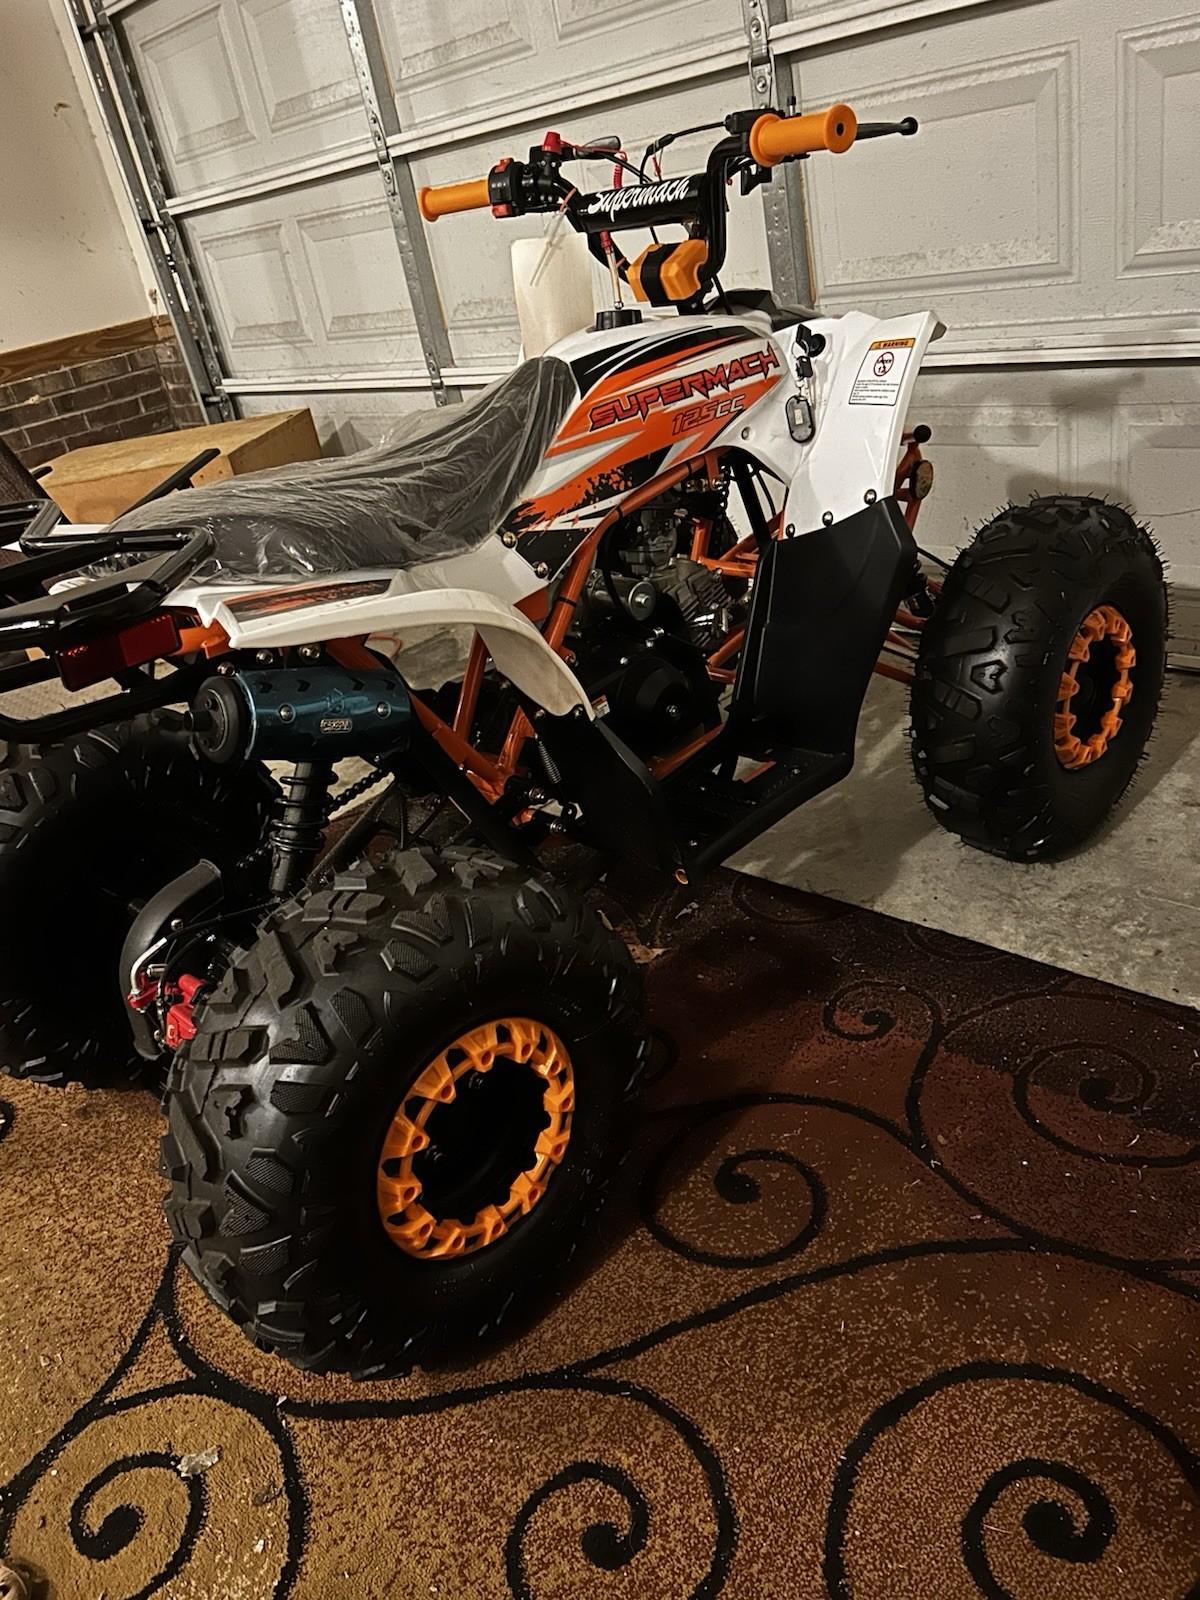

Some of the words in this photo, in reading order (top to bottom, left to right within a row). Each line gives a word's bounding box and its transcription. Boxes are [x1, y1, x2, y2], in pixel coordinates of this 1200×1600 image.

[587, 178, 690, 222] Supermach
[589, 341, 780, 432] SUPERMACH
[672, 394, 746, 436] 125CC
